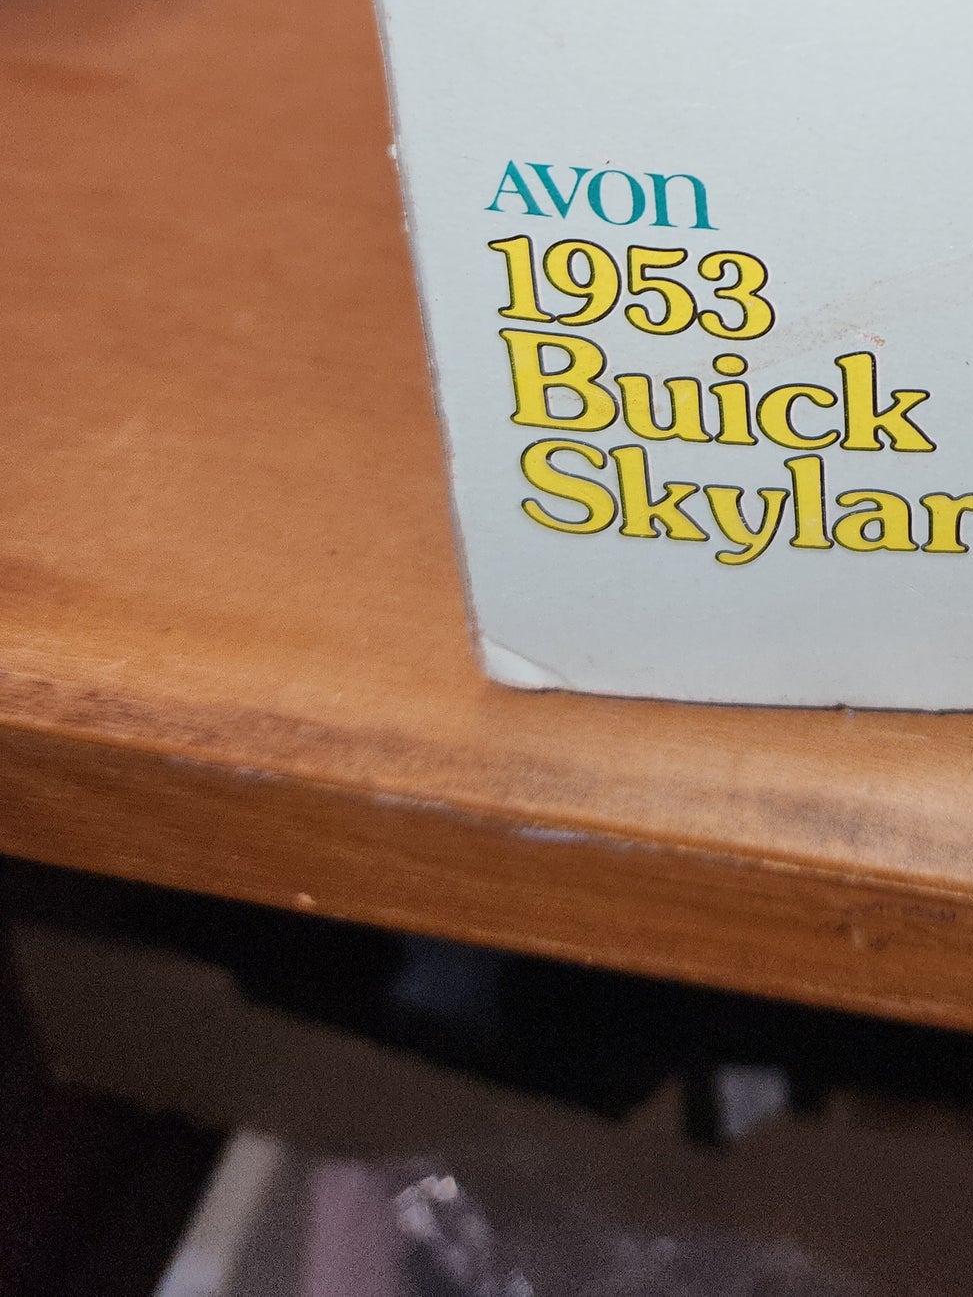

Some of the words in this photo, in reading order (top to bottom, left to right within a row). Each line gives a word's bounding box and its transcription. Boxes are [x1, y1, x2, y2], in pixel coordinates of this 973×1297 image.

[484, 159, 720, 231] AVON
[487, 234, 776, 341] 1953
[498, 327, 938, 453] Buick
